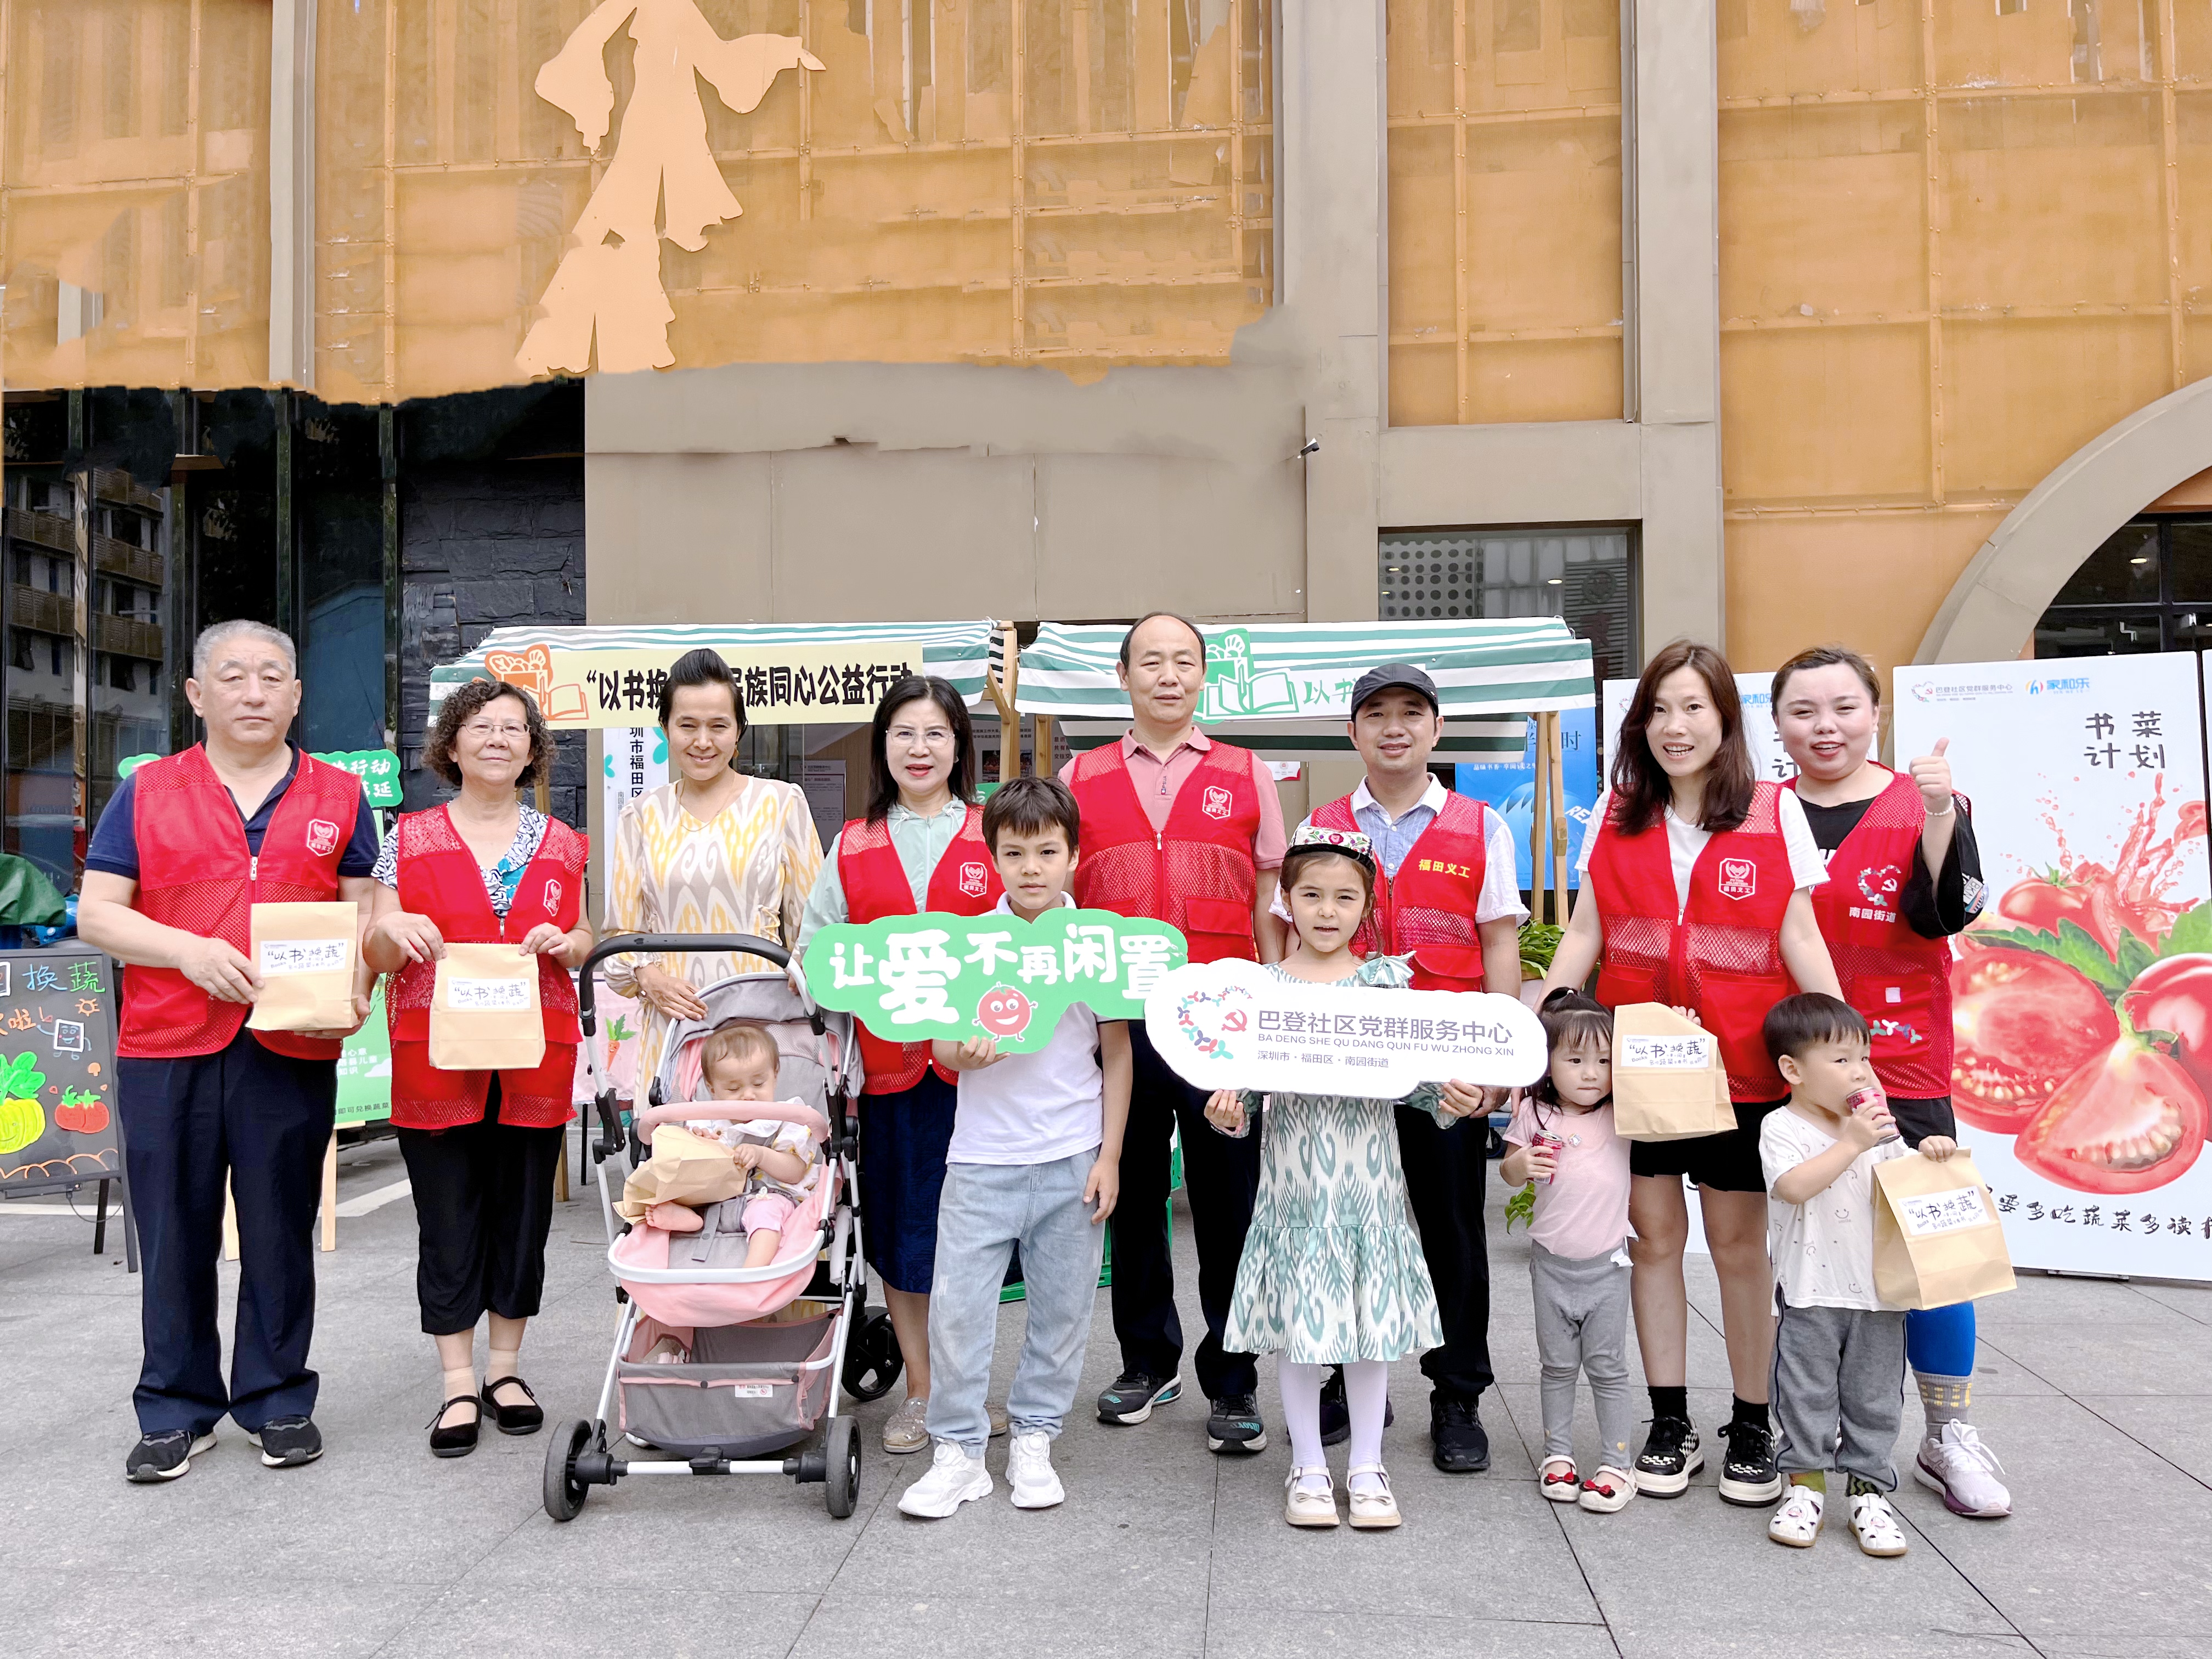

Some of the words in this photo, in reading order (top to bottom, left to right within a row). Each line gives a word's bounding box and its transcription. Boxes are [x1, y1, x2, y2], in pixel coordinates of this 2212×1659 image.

[2047, 678, 2090, 690] 家和乐
[2084, 742, 2165, 769] 计划
[1419, 859, 1470, 878] 福田义工
[1849, 907, 1897, 923] 南园街道
[22, 962, 105, 993] 换蔬
[830, 923, 1172, 1024] 让爱不再闲置
[1259, 1010, 1513, 1044] 巴登社区党群服务中心
[1259, 1034, 1273, 1042] BA
[1276, 1035, 1306, 1044] DENG
[1309, 1036, 1330, 1046] SHE
[1334, 1038, 1350, 1047] QU
[1352, 1040, 1384, 1048] DANG
[1387, 1041, 1411, 1051] QUN
[1414, 1043, 1428, 1051] FU
[1431, 1044, 1449, 1052] WU
[1452, 1046, 1492, 1056] ZHONG
[1494, 1047, 1514, 1056] XIN
[1257, 1051, 1290, 1062] 深圳市
[1301, 1053, 1334, 1064] 福田区
[1345, 1056, 1389, 1068] 南园街道
[1985, 1183, 2212, 1239] 要多吃蔬菜多读
